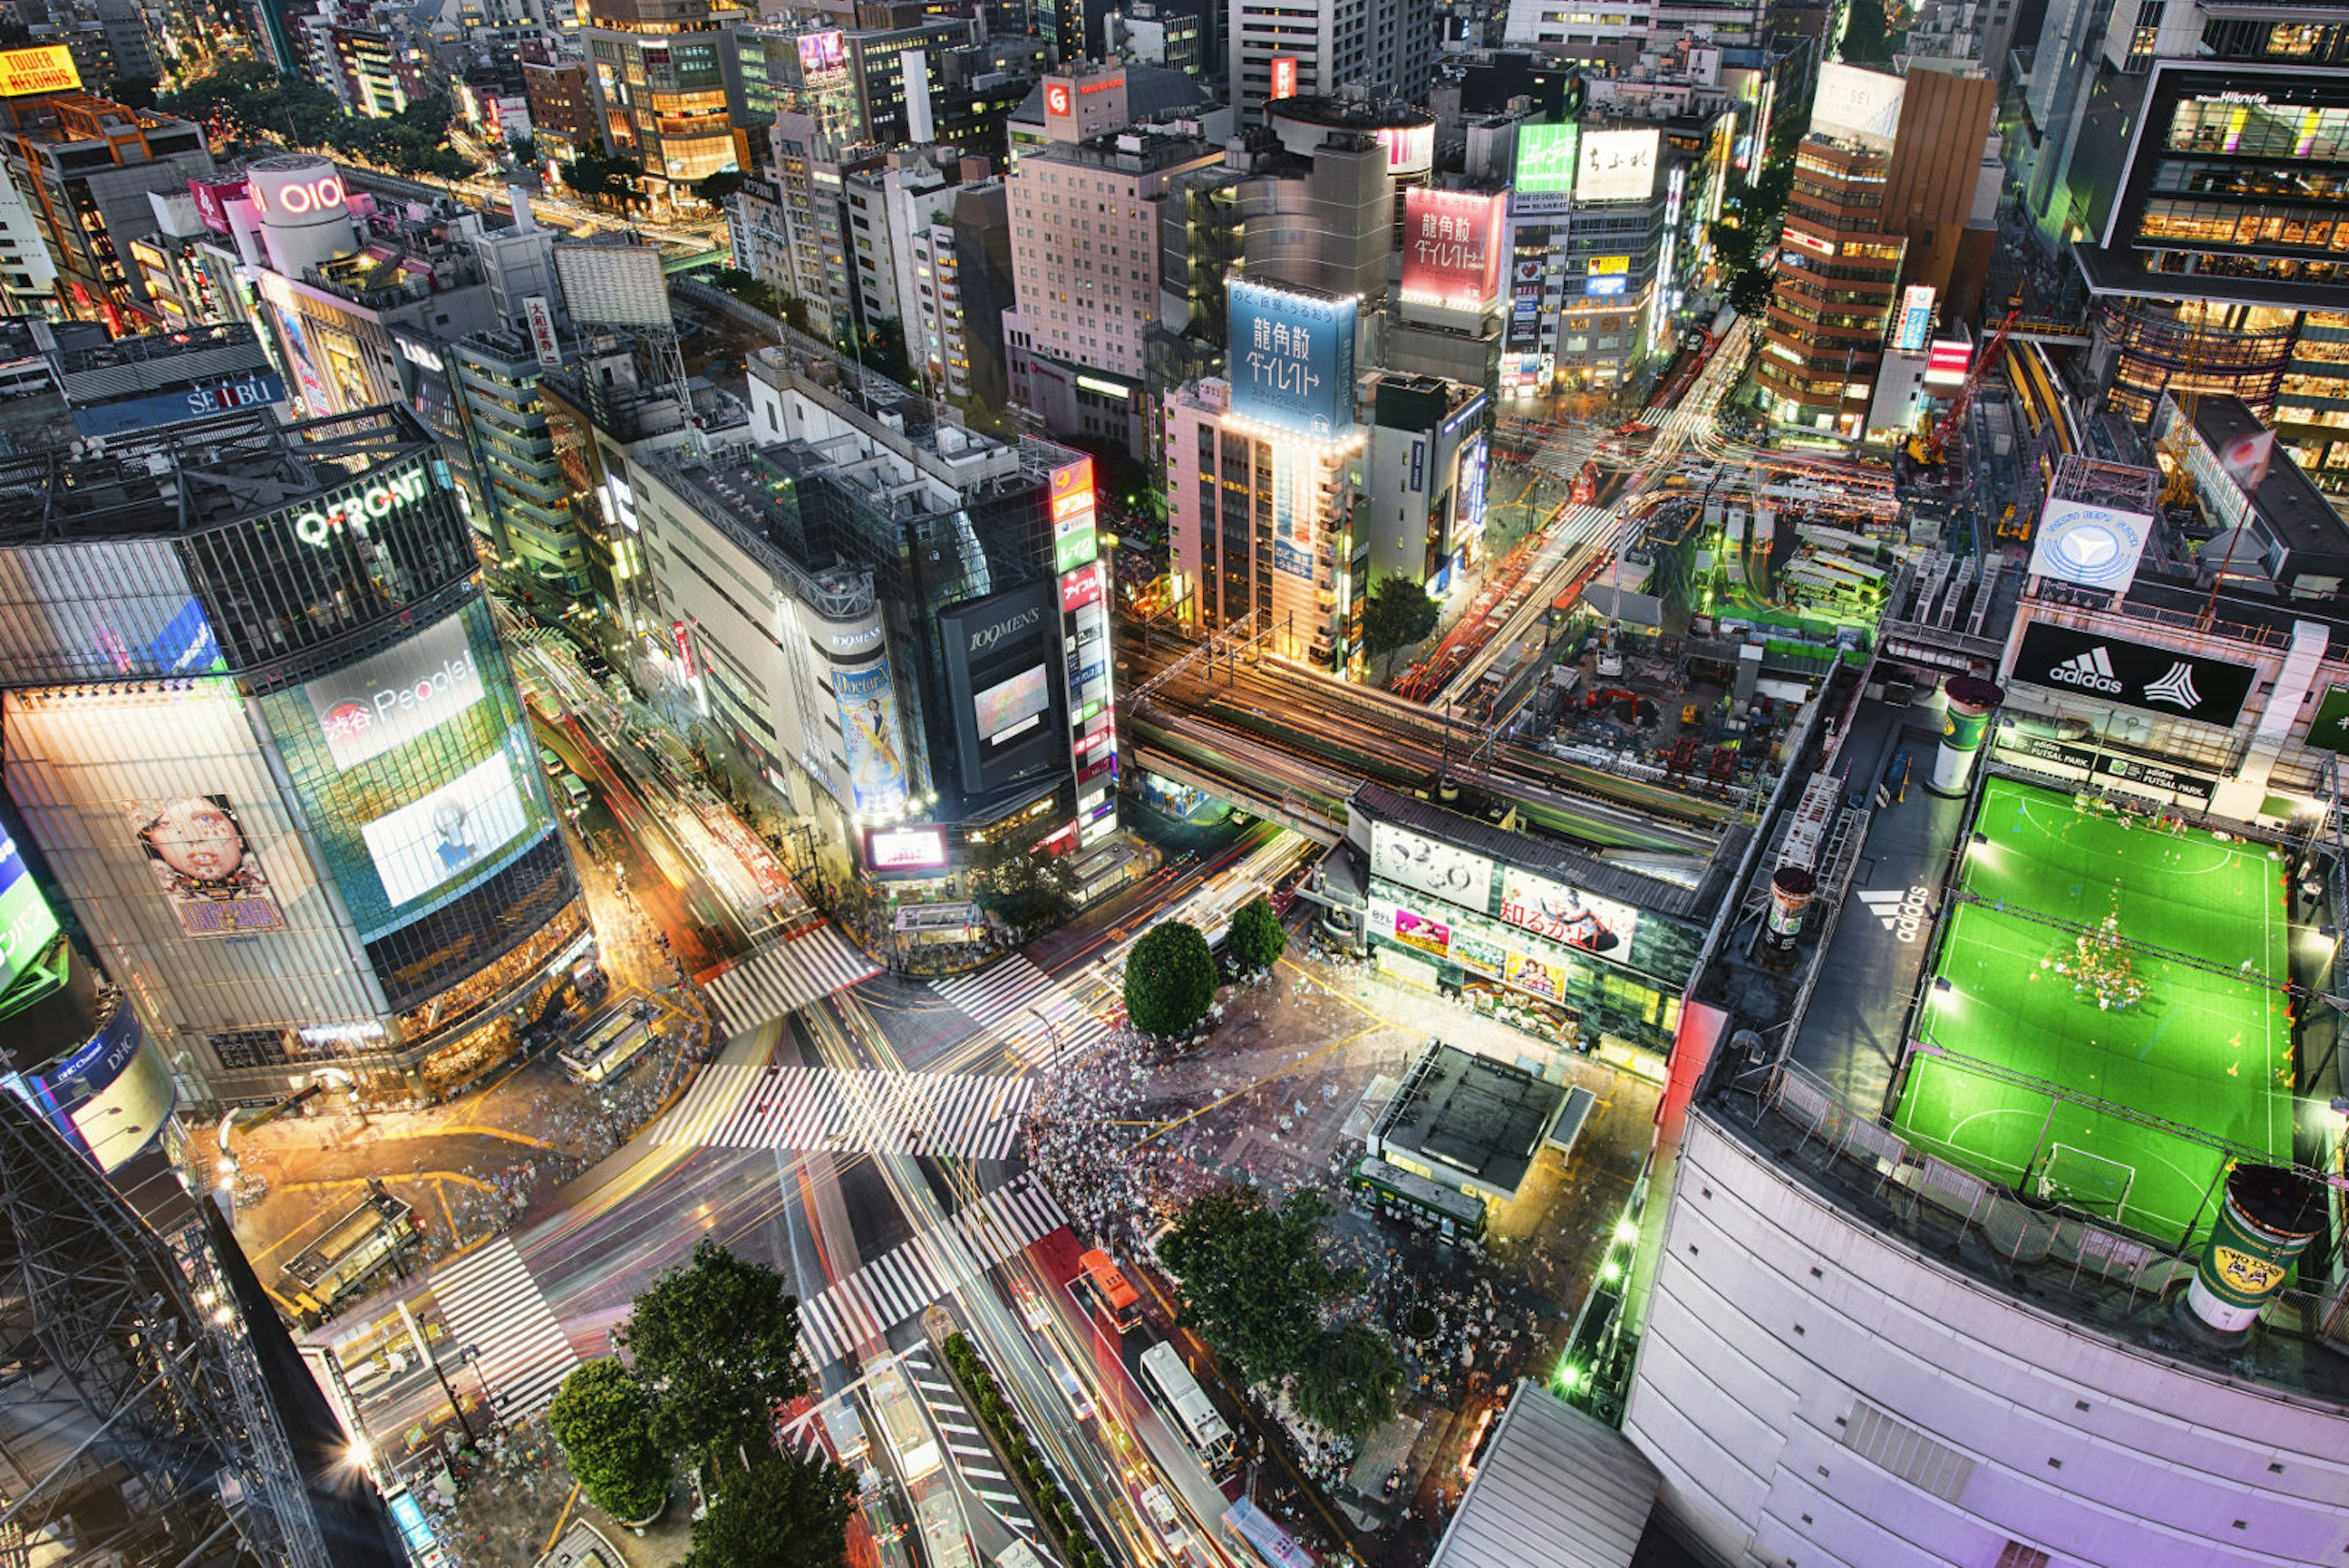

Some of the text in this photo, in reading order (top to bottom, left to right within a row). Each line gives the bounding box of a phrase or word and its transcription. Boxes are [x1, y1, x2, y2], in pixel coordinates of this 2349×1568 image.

[4, 51, 55, 72] TOWER
[8, 69, 72, 91] RECORDS
[1590, 147, 1647, 172] ちふれ
[1422, 212, 1470, 243] 龍角散
[393, 336, 444, 372] ZARA
[1253, 316, 1310, 361] 龍角散
[187, 380, 272, 415] SEIBU
[295, 467, 426, 548] QFRONT
[1060, 537, 1093, 562] レイク
[2049, 667, 2122, 694] adidas
[321, 705, 373, 740] 渋谷
[2143, 775, 2176, 791] FUTSAL
[1895, 885, 1929, 943] adidas
[106, 1033, 134, 1071] DHC
[2219, 1249, 2249, 1264] TWO
